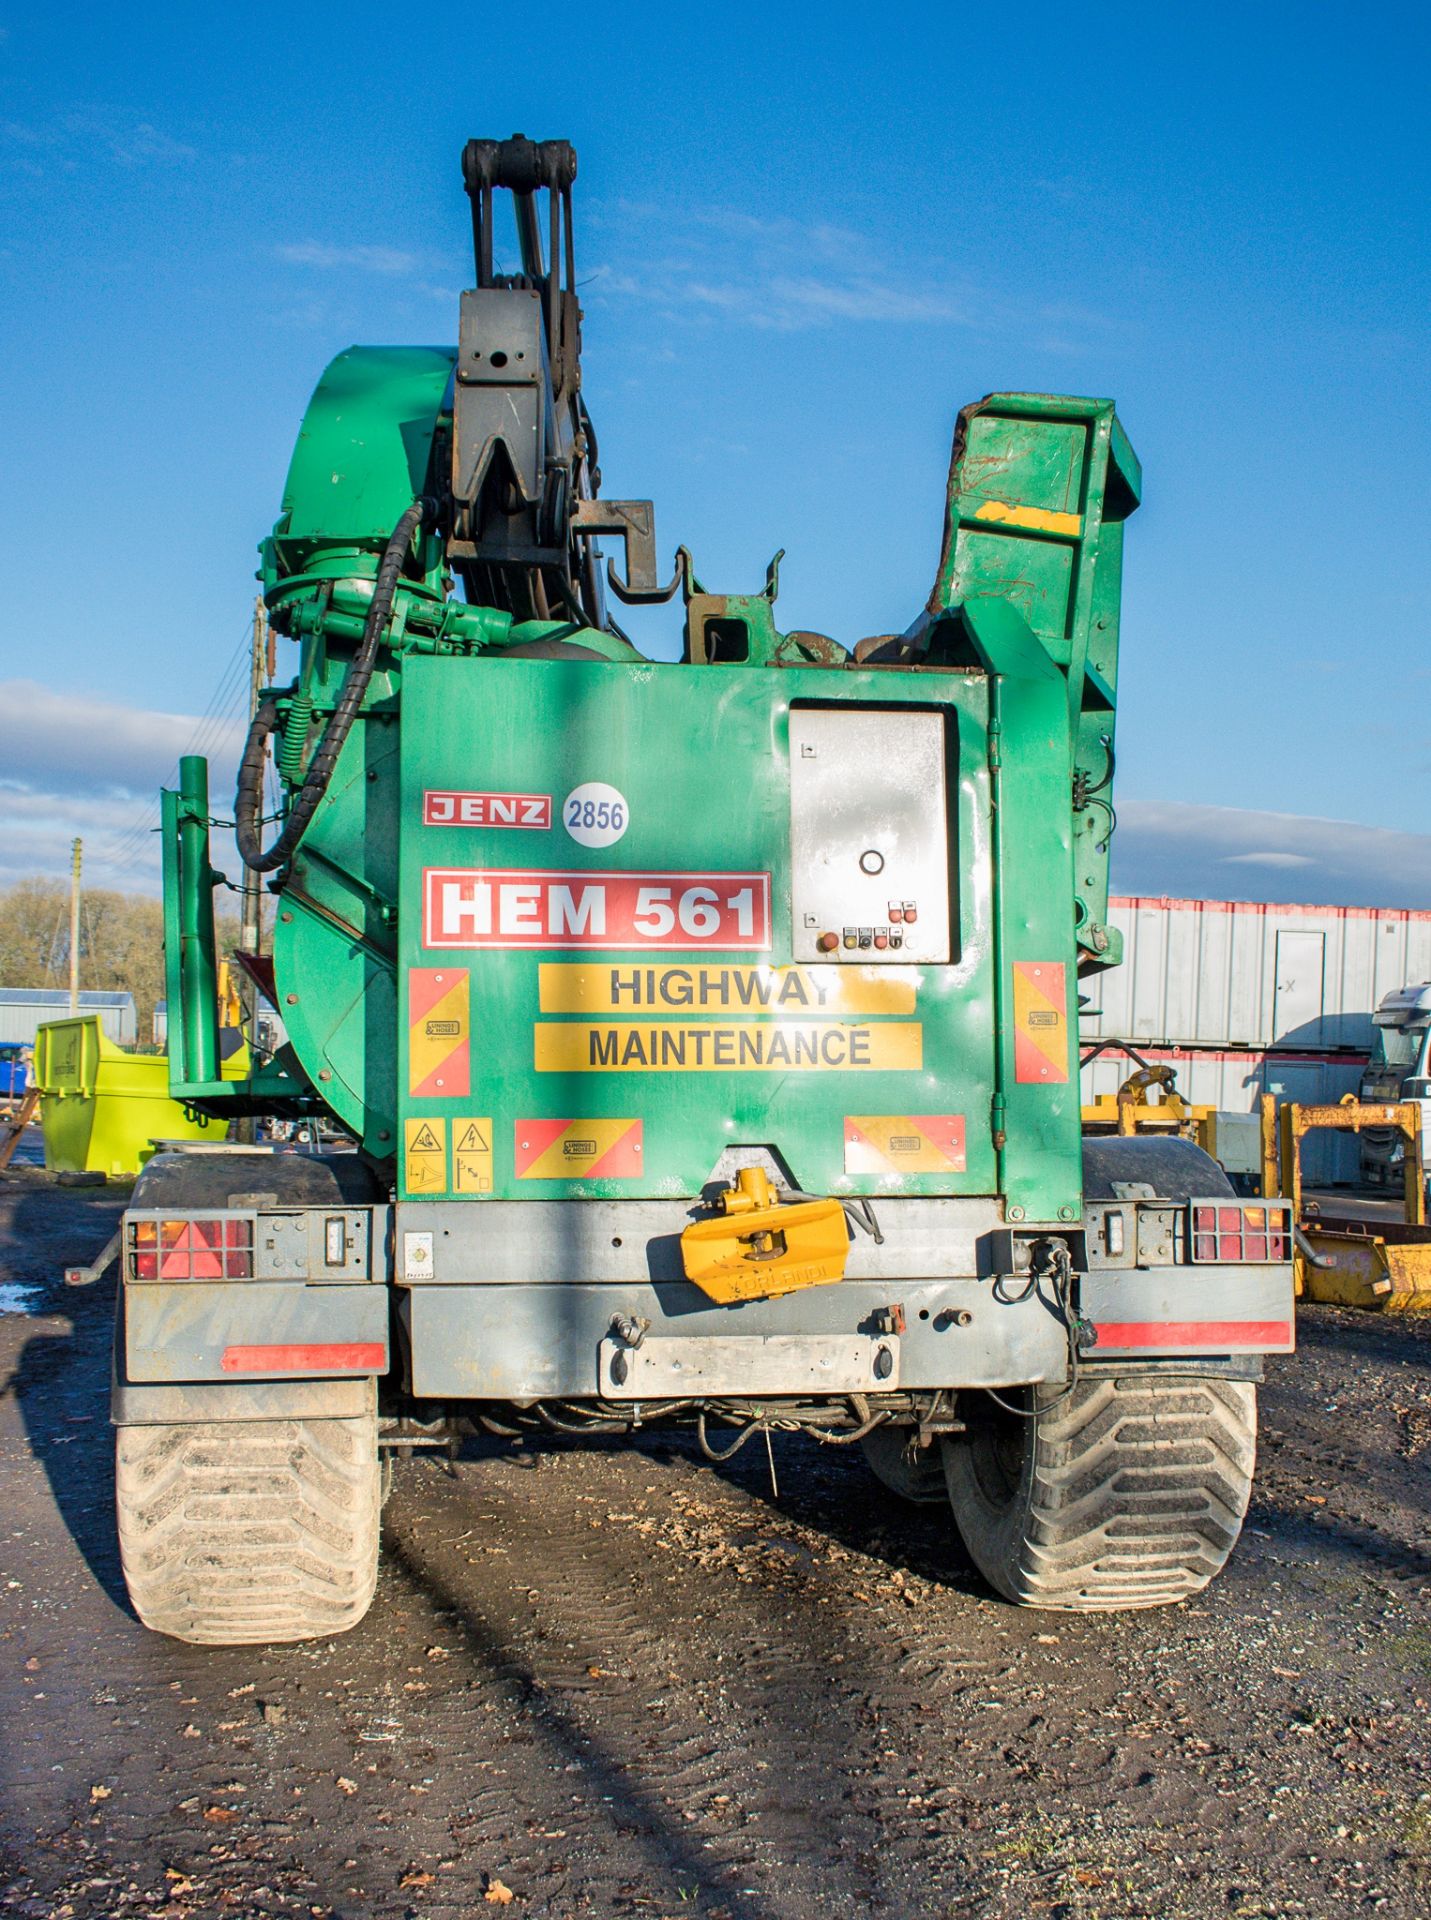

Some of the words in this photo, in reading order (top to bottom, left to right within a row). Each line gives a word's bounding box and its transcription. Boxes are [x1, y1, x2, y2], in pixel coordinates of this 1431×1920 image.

[431, 797, 545, 823] JENZ
[568, 800, 623, 830] 2856
[442, 883, 606, 935] HEM
[633, 887, 753, 937] 561
[610, 969, 836, 1005] HIGHWAY
[589, 1030, 871, 1066] MAINTENANCE
